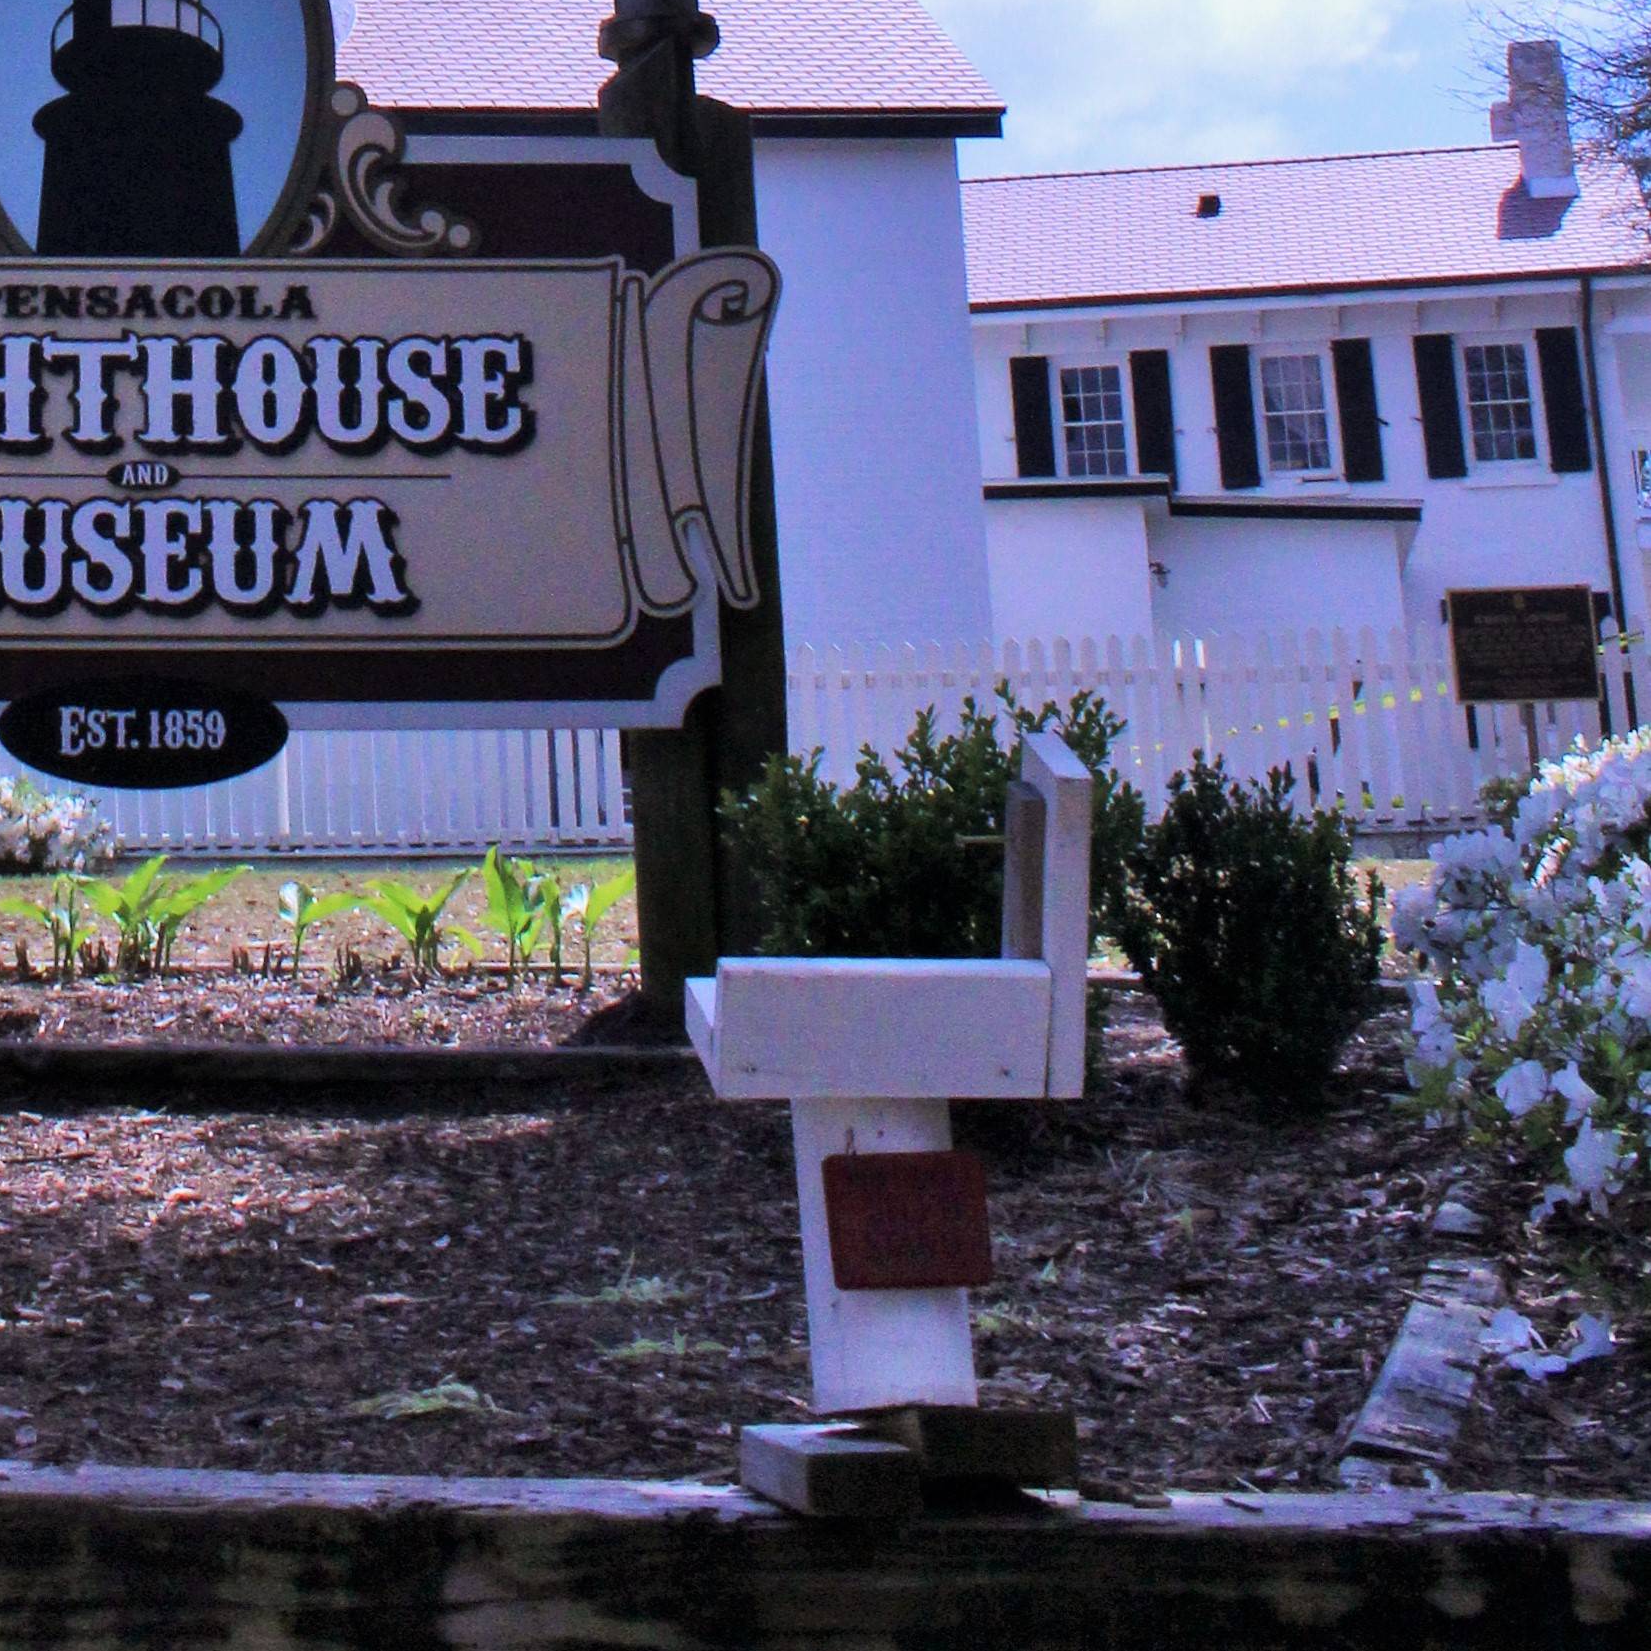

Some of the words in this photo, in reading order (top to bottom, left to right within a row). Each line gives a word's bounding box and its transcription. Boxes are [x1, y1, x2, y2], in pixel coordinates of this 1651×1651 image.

[120, 462, 170, 487] AND
[58, 705, 140, 756] EST.
[148, 708, 227, 750] 1859
